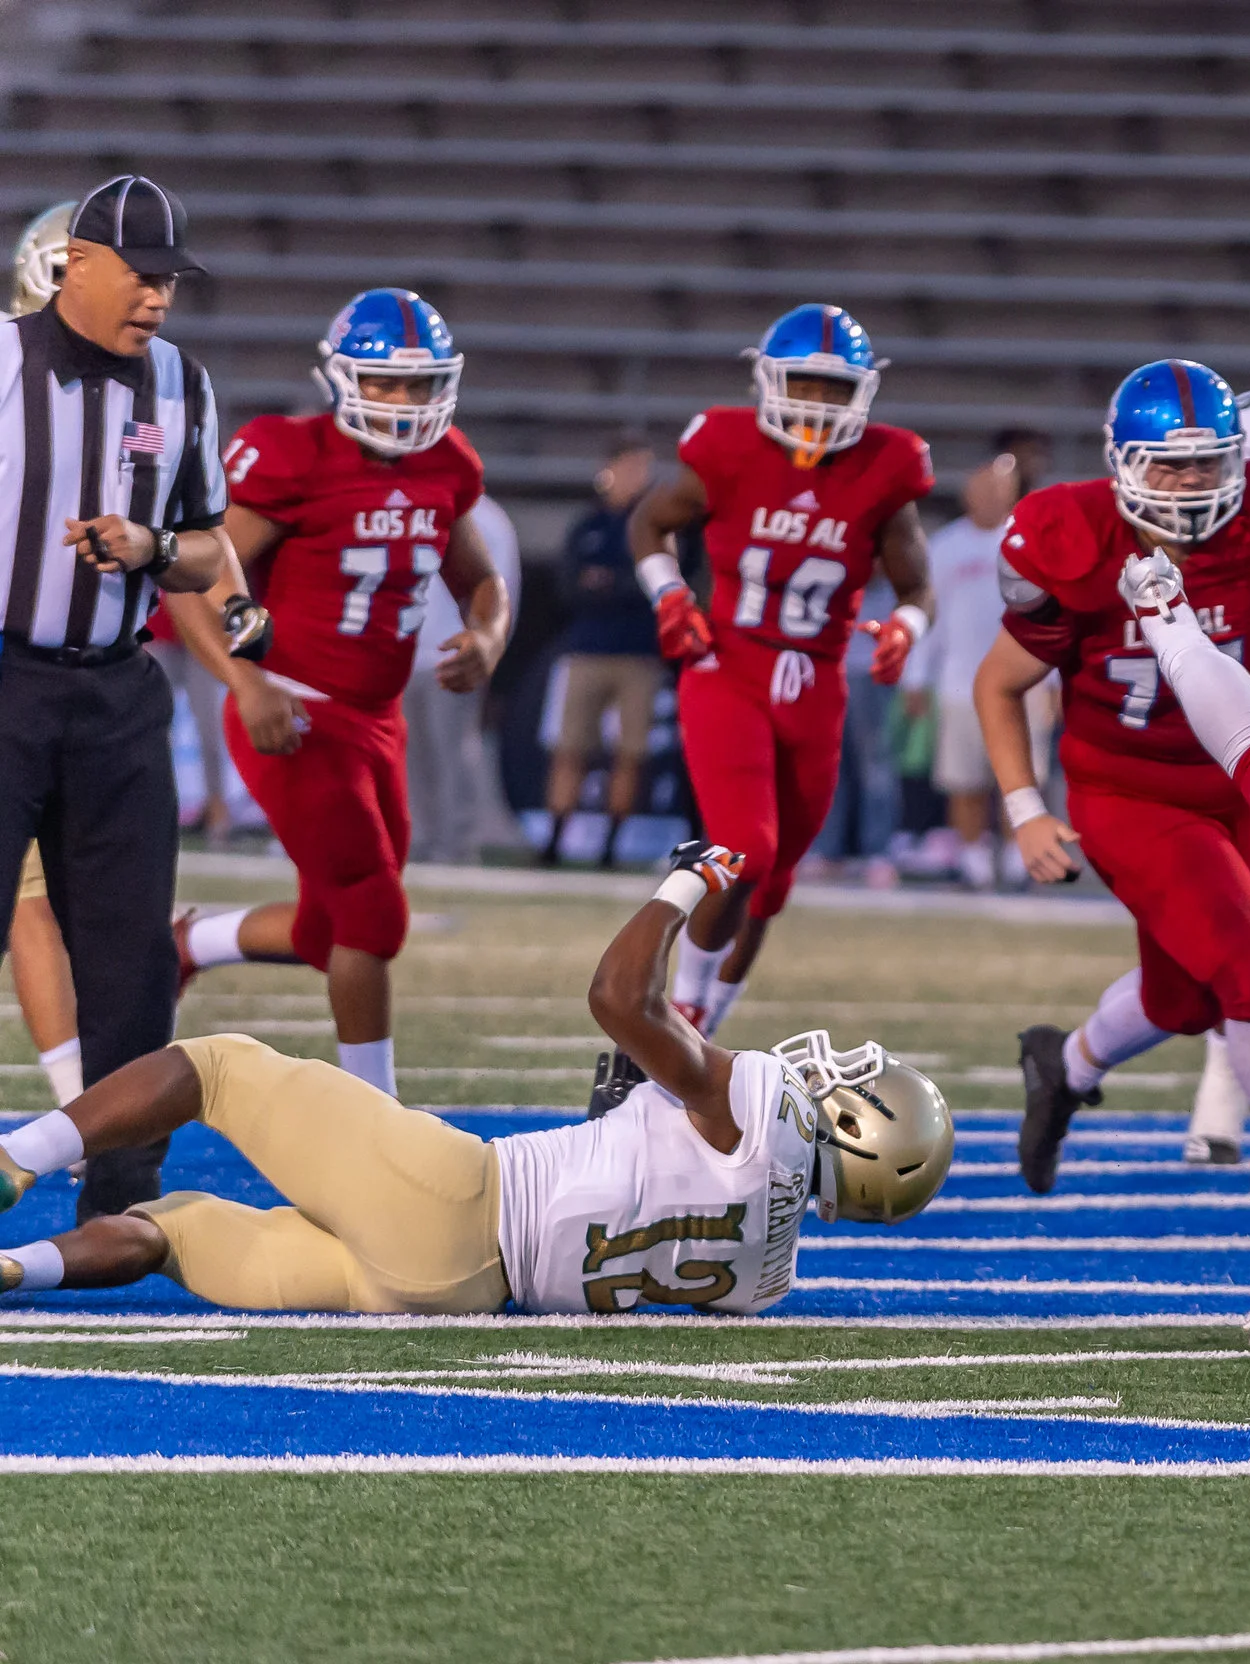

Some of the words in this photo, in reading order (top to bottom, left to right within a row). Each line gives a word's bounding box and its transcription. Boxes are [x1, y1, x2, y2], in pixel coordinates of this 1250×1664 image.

[354, 508, 405, 540] LOS
[409, 508, 439, 539] AL
[750, 506, 810, 544] LOS
[806, 517, 848, 553] AL
[777, 1064, 816, 1144] 12
[582, 1201, 748, 1315] 12
